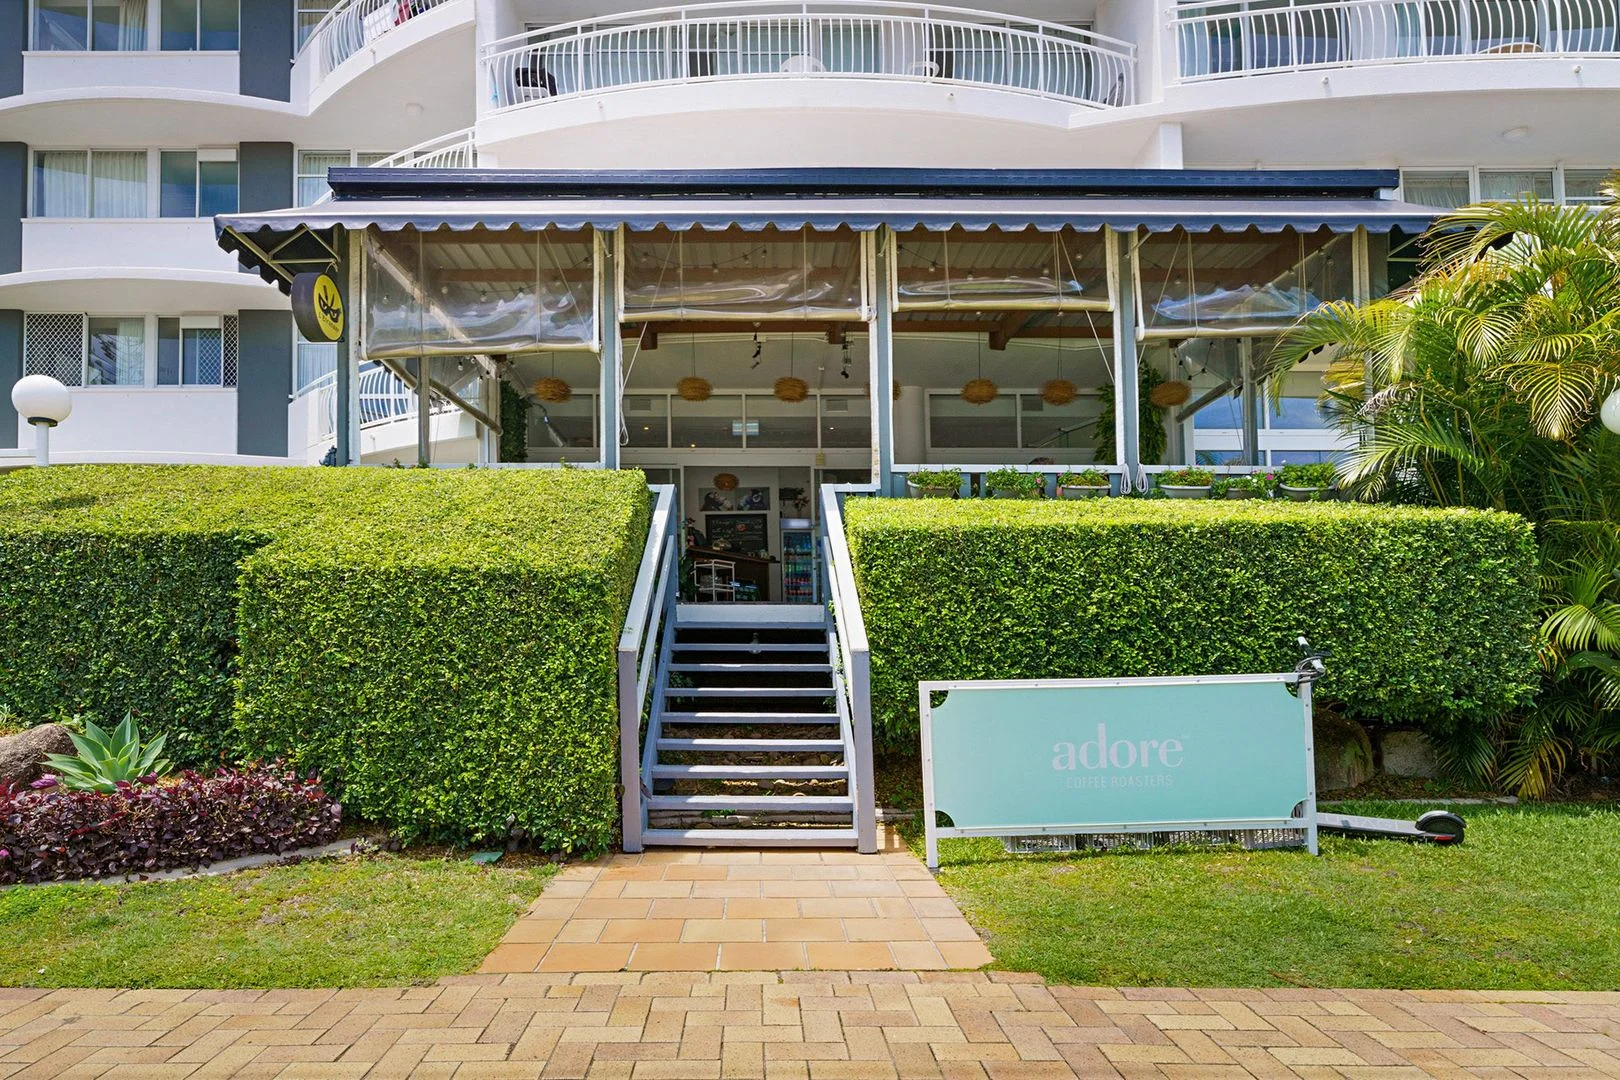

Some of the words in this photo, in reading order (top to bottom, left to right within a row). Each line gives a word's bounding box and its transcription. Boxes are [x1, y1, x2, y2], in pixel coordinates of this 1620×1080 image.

[1051, 722, 1184, 771] adore
[1066, 776, 1107, 789] COFFEE
[1111, 774, 1174, 788] ROASTERS
